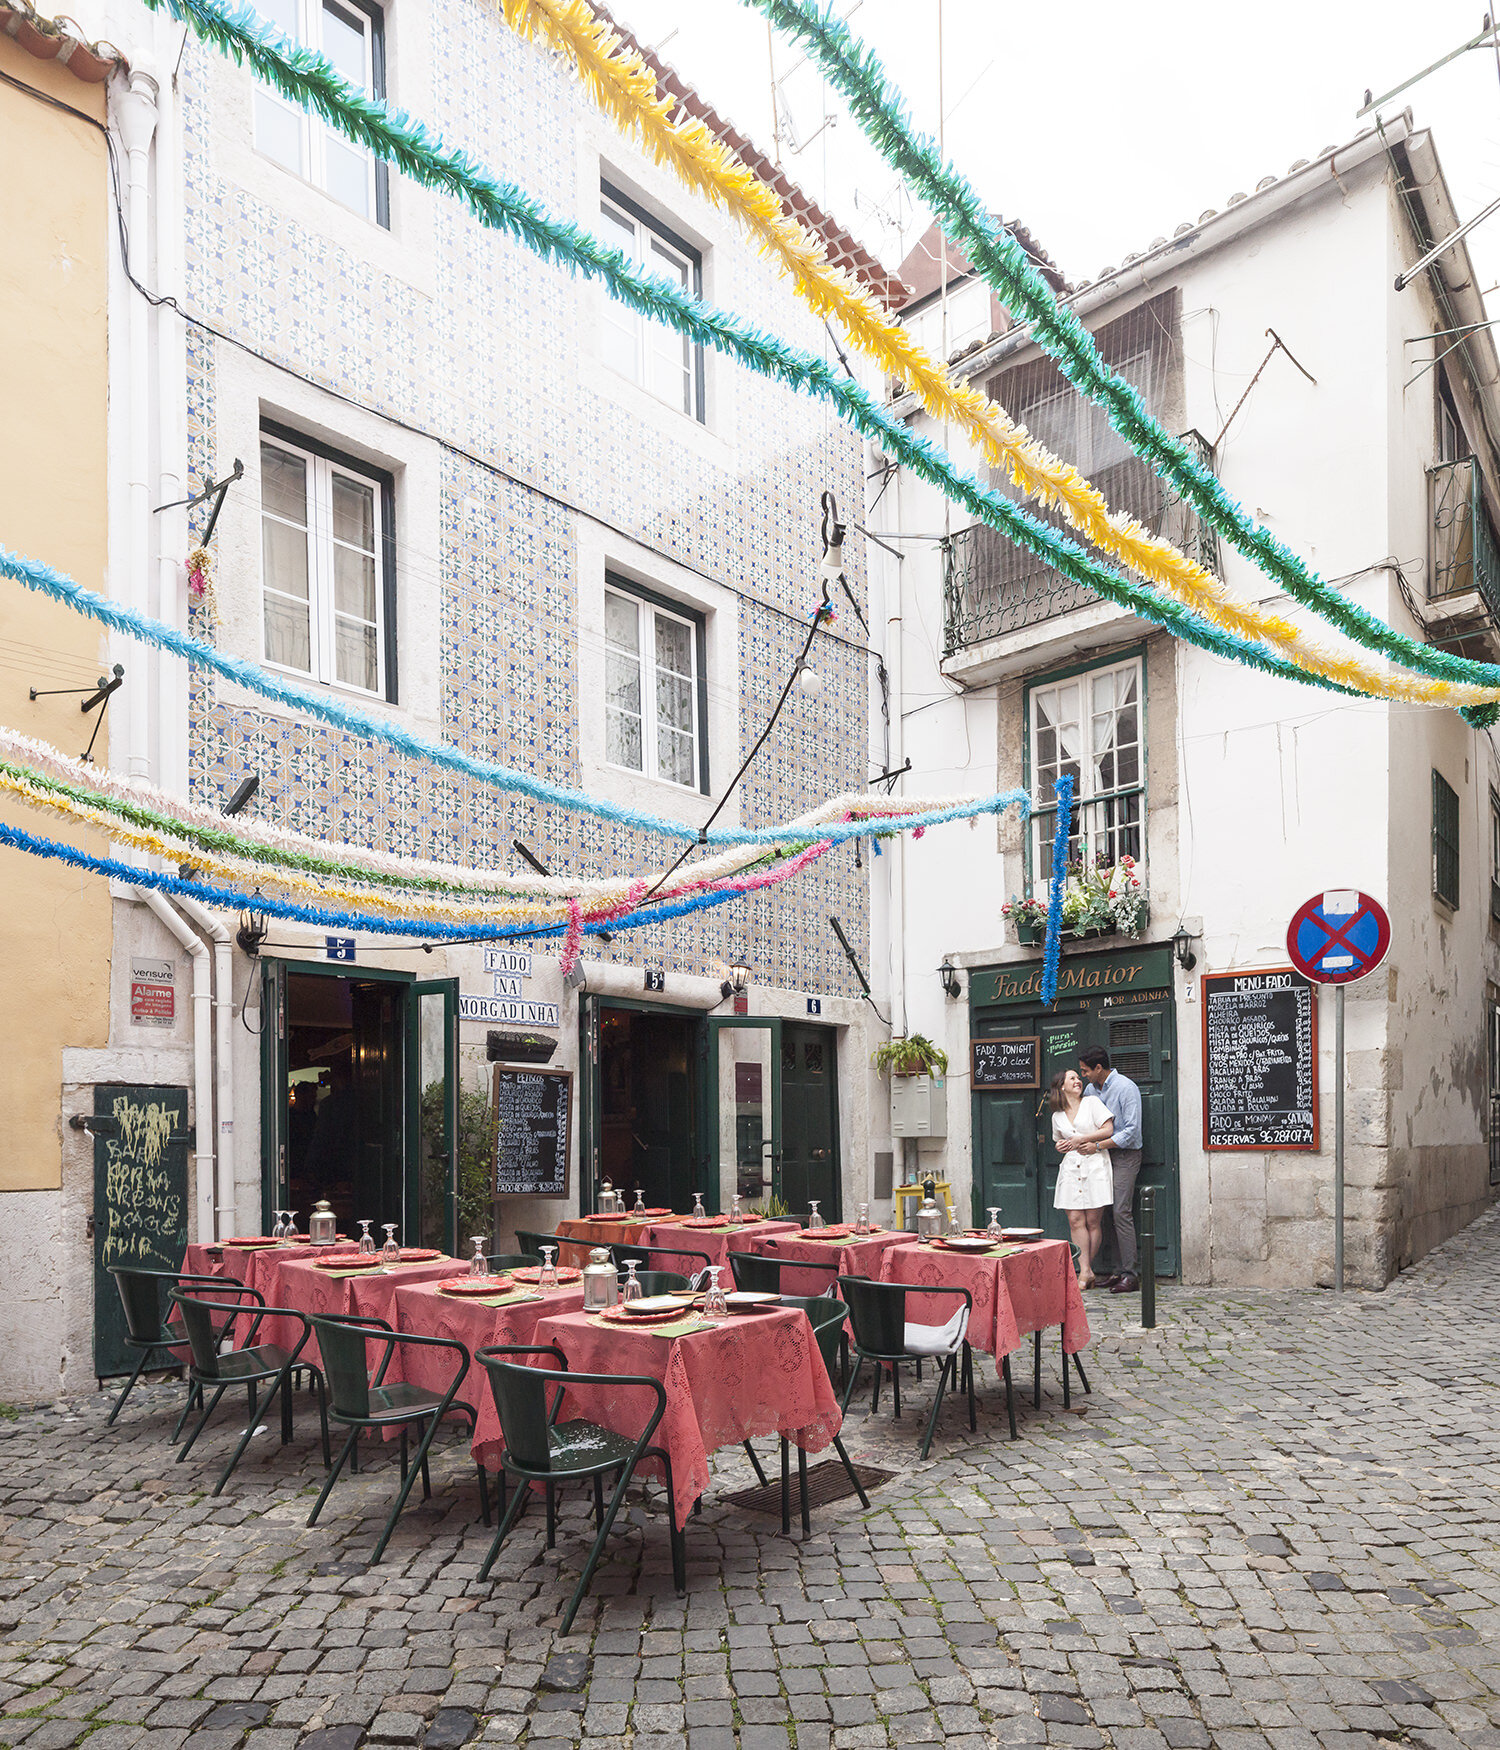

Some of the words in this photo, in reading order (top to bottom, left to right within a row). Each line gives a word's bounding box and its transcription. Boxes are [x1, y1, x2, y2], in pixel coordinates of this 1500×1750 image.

[336, 938, 346, 959] 5
[490, 952, 526, 971] FADO
[133, 969, 173, 979] verisure
[1058, 964, 1144, 990] Maior
[499, 978, 517, 994] NA
[134, 986, 172, 998] Alarme
[1185, 986, 1193, 997] 7
[811, 999, 817, 1013] 6
[1079, 999, 1092, 1009] BY
[1244, 999, 1267, 1009] ARROZ
[459, 999, 554, 1022] MORGADINHA
[1209, 1010, 1239, 1019] ALHEIRA
[1242, 1014, 1267, 1023] ASSADO
[1208, 1025, 1229, 1033] MISTA
[1238, 1029, 1270, 1039] QUEIJOS
[1209, 1038, 1231, 1046] MISTA
[975, 1044, 997, 1056] FADO
[1209, 1044, 1248, 1053] LOMBINHOS
[988, 1055, 1007, 1067] 7.30
[1209, 1053, 1229, 1061] PREGO
[1209, 1060, 1229, 1069] OVOS
[1209, 1066, 1244, 1076] BACALHAU
[1209, 1076, 1237, 1085] FRANGO
[1233, 1090, 1253, 1098] FRITO
[1209, 1097, 1236, 1105] SALADA
[1247, 1095, 1279, 1104] BACALHAU
[1210, 1104, 1236, 1112] SALADA
[1247, 1103, 1270, 1111] POLVO
[1209, 1115, 1232, 1129] FADO
[1210, 1133, 1256, 1145] RESERVAS
